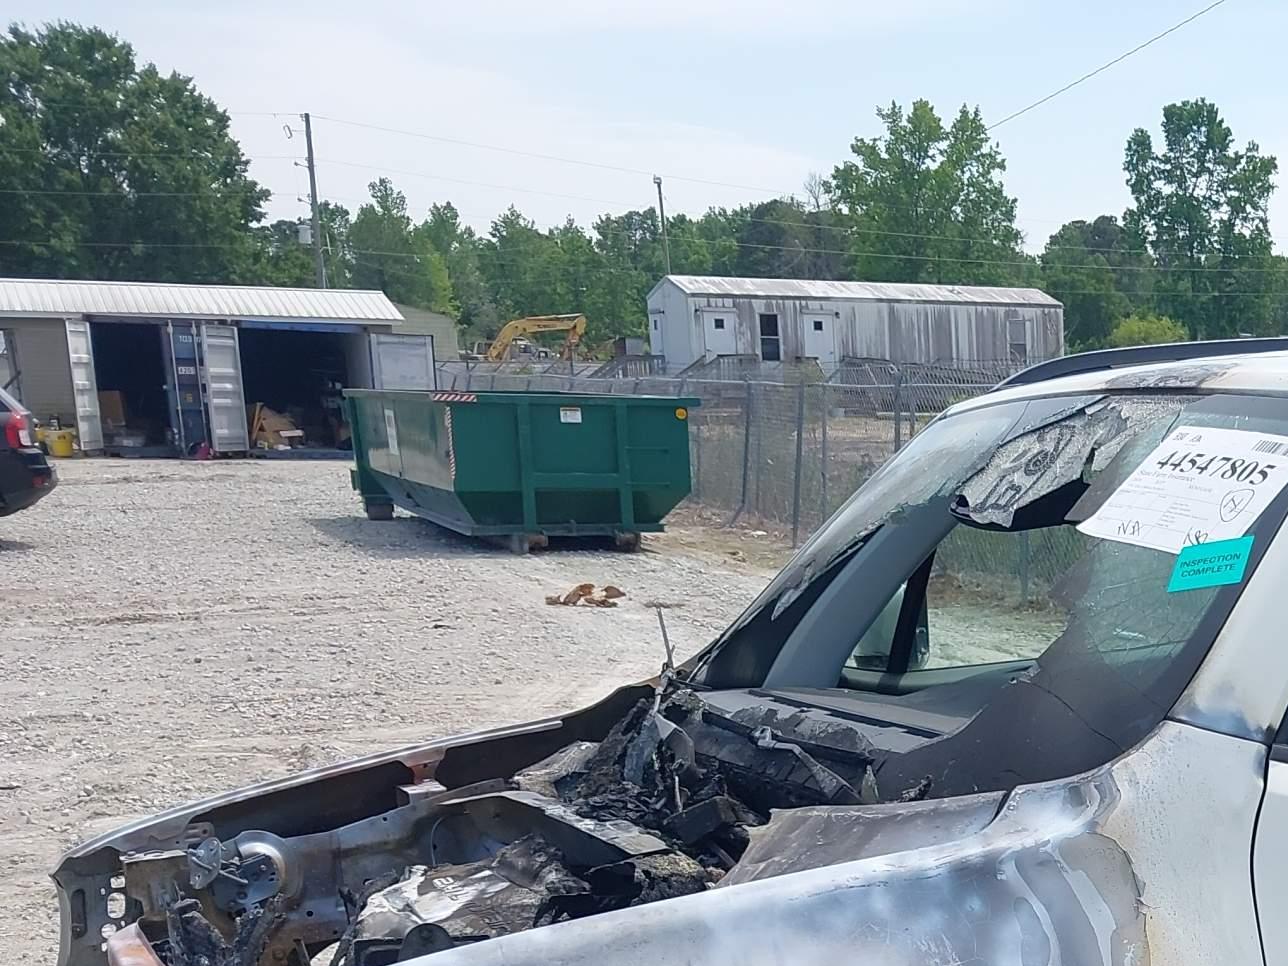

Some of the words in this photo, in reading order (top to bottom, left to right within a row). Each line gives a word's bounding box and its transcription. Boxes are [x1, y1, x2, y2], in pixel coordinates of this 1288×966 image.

[1157, 450, 1277, 485] 44547805
[1180, 552, 1241, 568] INSPECTION
[1181, 563, 1236, 578] COMPLETE
